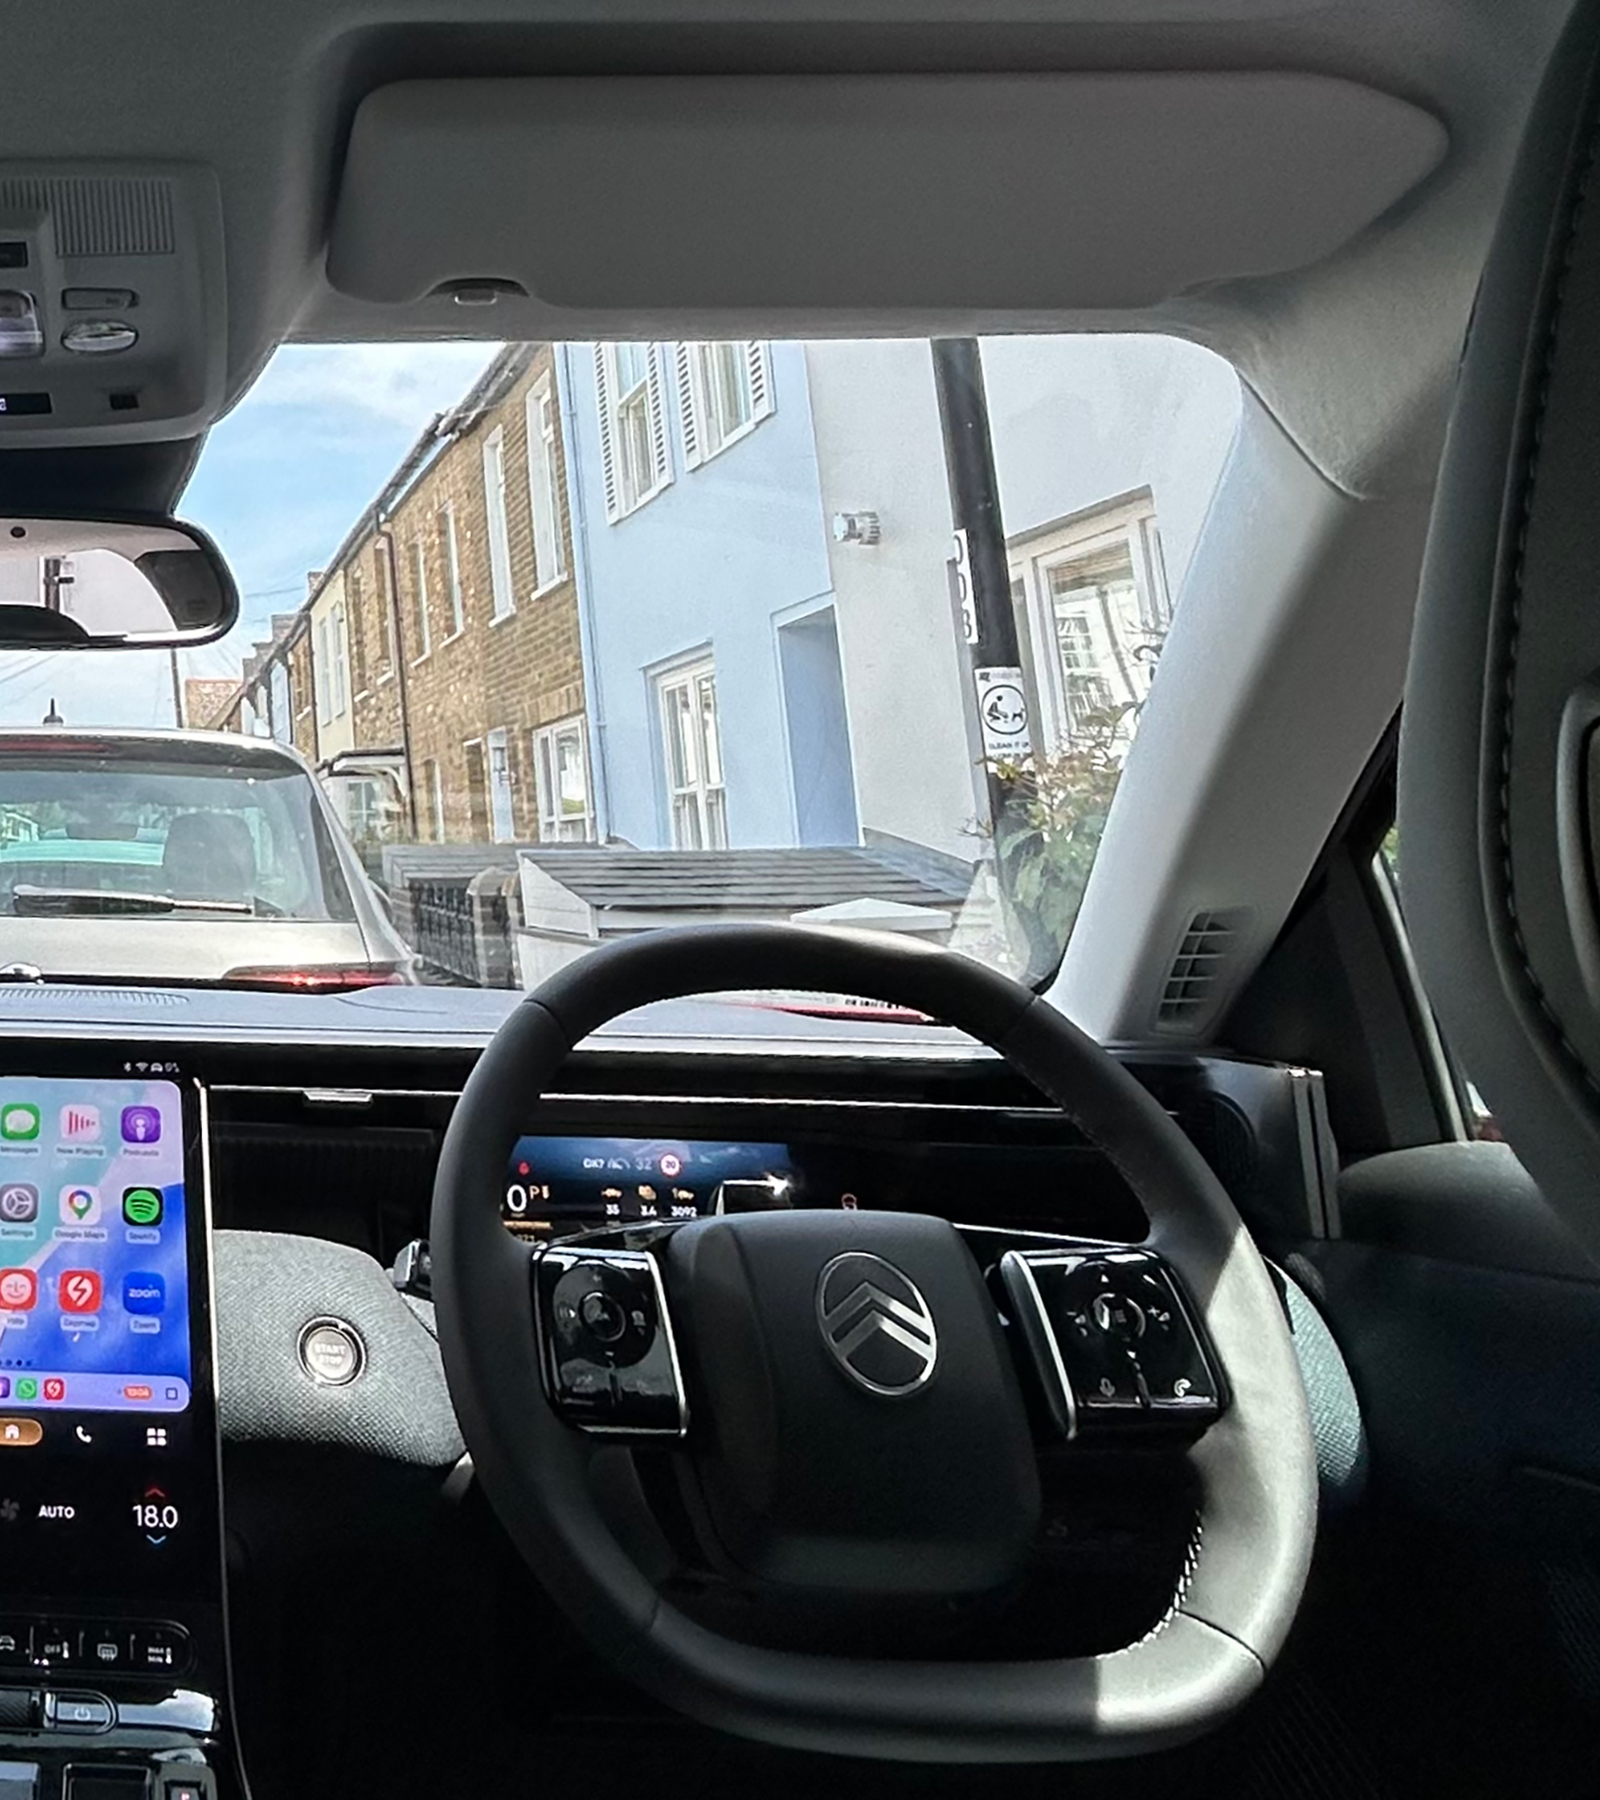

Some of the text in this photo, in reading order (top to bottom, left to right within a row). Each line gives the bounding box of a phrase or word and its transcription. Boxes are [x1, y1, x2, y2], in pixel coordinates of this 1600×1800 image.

[0, 1146, 38, 1154] Messages
[76, 1148, 103, 1157] Playing
[123, 1148, 159, 1156] Podcasts
[665, 1161, 676, 1169] 20
[530, 1186, 540, 1199] P
[507, 1185, 527, 1212] 0
[671, 1206, 697, 1217] 3092
[1, 1229, 34, 1237] Settings
[128, 1288, 160, 1298] zoom
[314, 1343, 346, 1355] START
[318, 1354, 343, 1365] STOP
[38, 1506, 75, 1519] AUTO
[132, 1504, 178, 1528] 18.0
